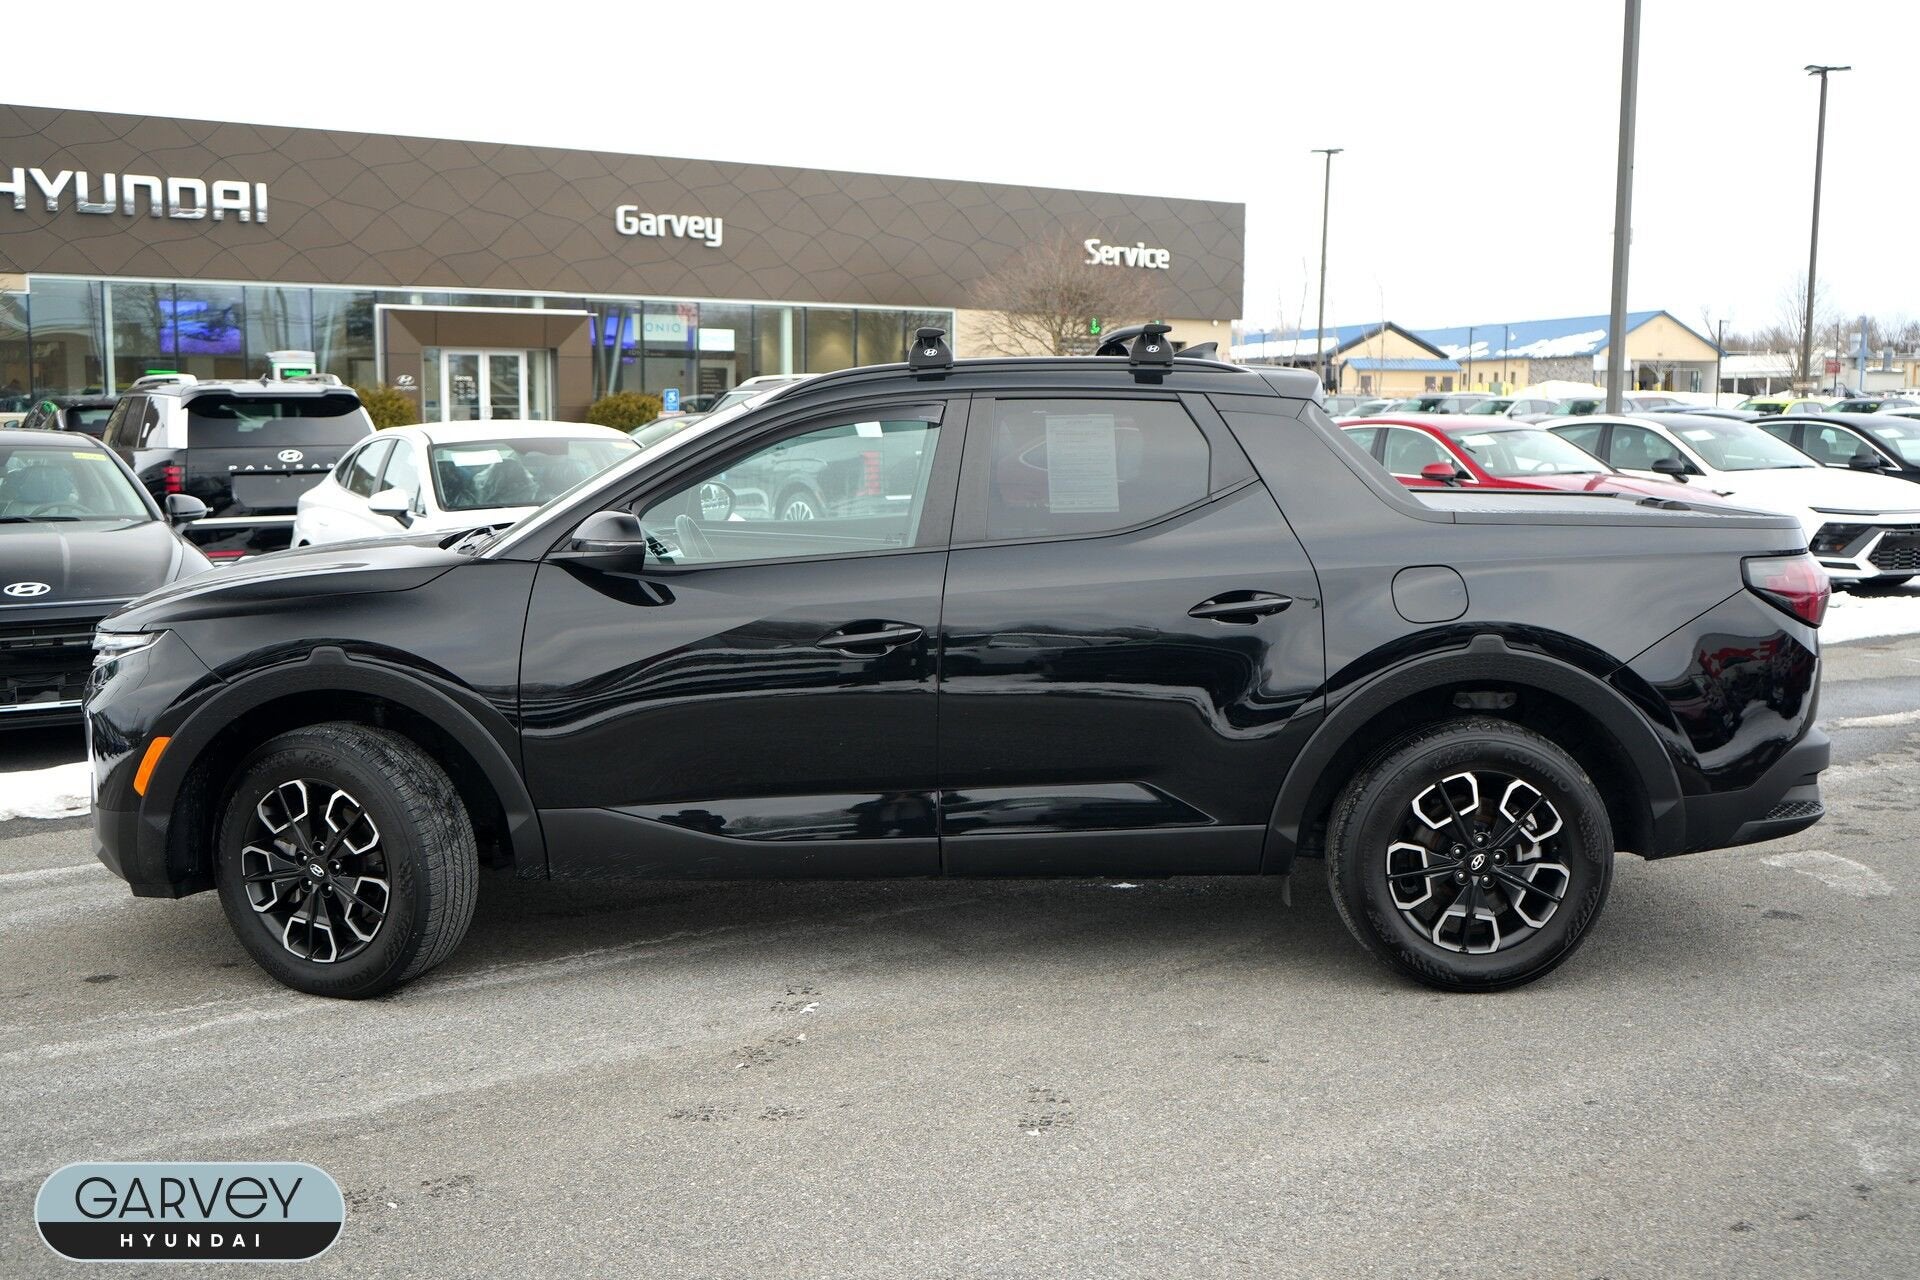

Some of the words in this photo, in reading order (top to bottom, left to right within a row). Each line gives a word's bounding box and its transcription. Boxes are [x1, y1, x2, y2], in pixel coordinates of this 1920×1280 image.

[614, 204, 723, 248] Garvey
[1084, 238, 1171, 270] Service
[228, 463, 336, 471] PALISAD
